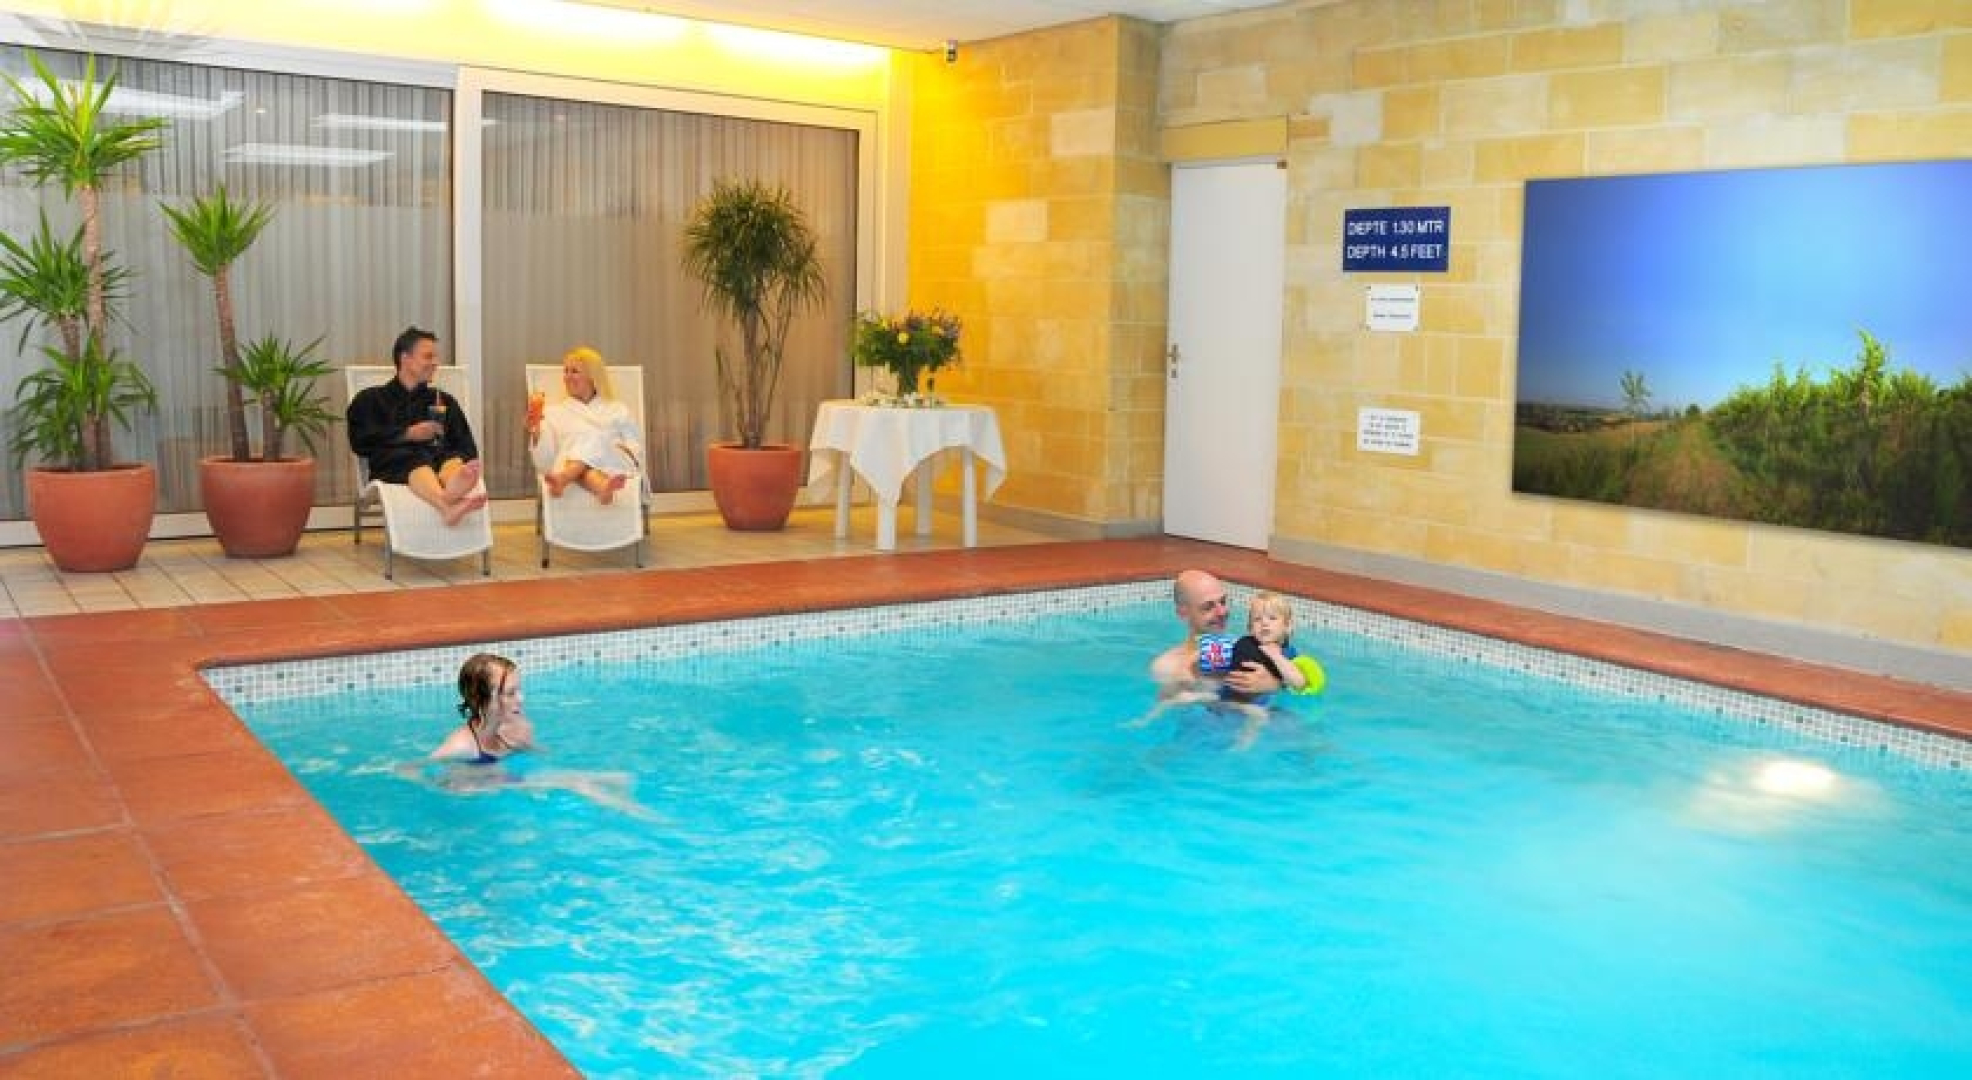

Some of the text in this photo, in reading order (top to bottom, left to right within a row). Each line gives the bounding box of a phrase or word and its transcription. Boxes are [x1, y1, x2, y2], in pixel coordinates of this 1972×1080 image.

[1347, 221, 1388, 235] DIEPTE
[1417, 220, 1445, 233] MTR
[1347, 245, 1386, 258] DEPTH
[1411, 244, 1442, 258] FEET
